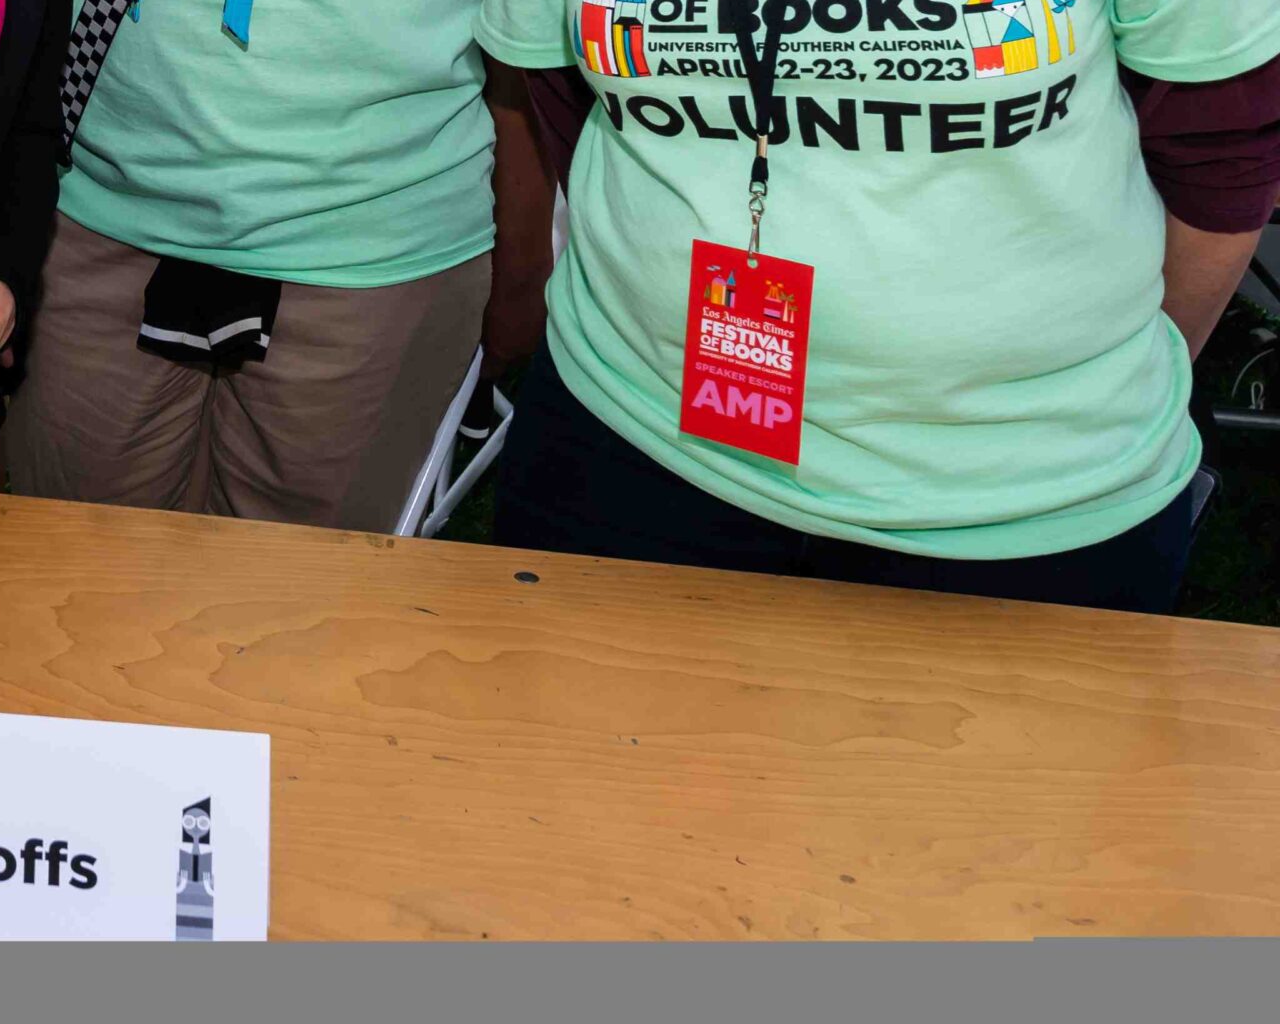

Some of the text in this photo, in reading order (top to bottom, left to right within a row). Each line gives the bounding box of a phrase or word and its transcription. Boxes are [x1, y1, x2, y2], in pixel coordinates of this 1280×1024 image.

[647, 41, 739, 53] UNIVERSITY
[776, 40, 855, 53] OUTHERN
[858, 39, 965, 53] CALIFORNIA
[657, 57, 970, 82] APRIL 2-23, 2023
[701, 318, 794, 357] FESTIVAL
[702, 306, 795, 338] Los Angeles Times
[700, 334, 720, 348] OF
[720, 339, 793, 372] BOOKS
[695, 361, 746, 384] SPEAKER
[748, 376, 794, 395] ESCORT
[691, 379, 793, 430] AMP
